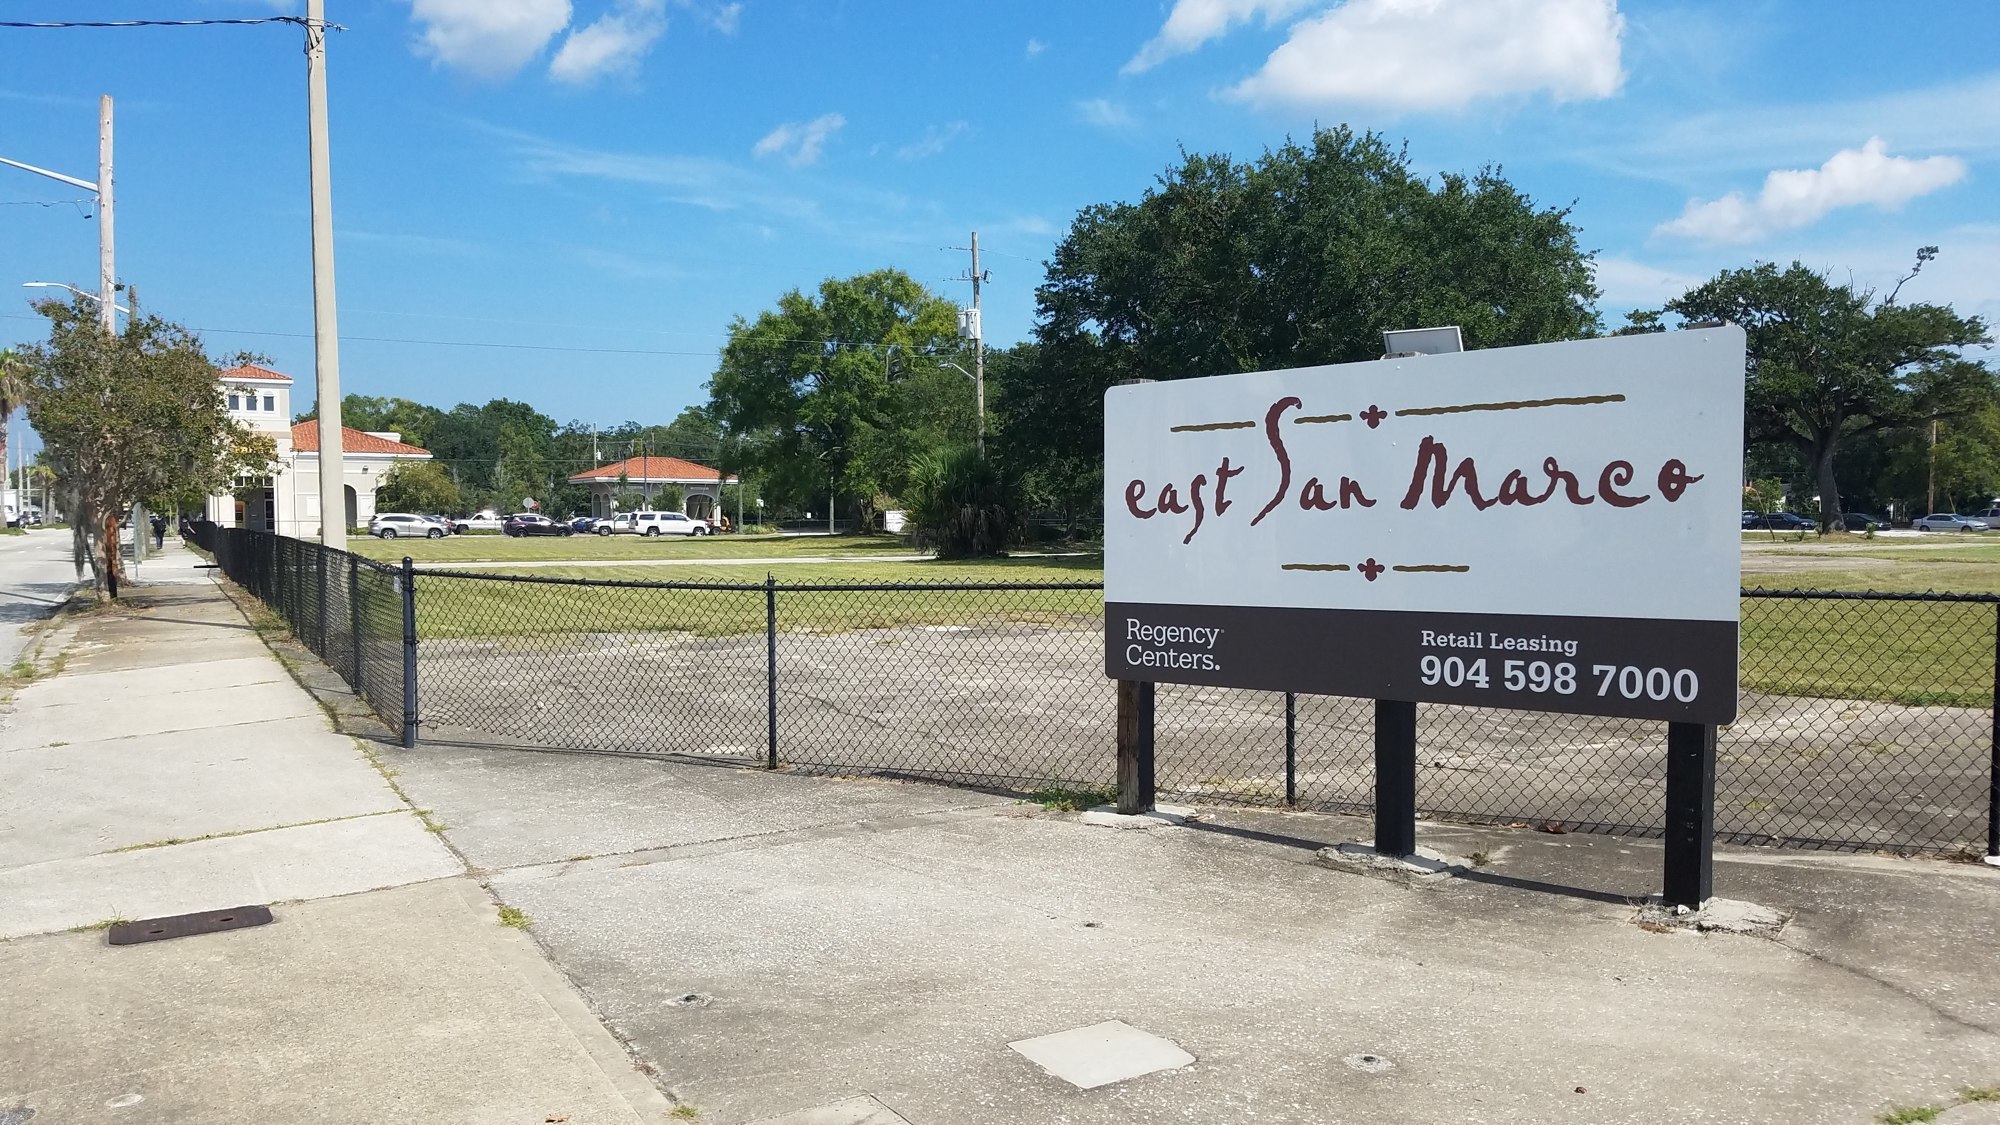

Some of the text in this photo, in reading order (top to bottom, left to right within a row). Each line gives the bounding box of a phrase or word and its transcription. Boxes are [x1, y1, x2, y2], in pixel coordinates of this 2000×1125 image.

[1125, 396, 1705, 545] east San Marco
[1126, 618, 1220, 650] Regency
[1421, 630, 1579, 657] Retail Leasing
[1126, 644, 1221, 671] Centers.
[1420, 655, 1699, 703] 904 598 7000
